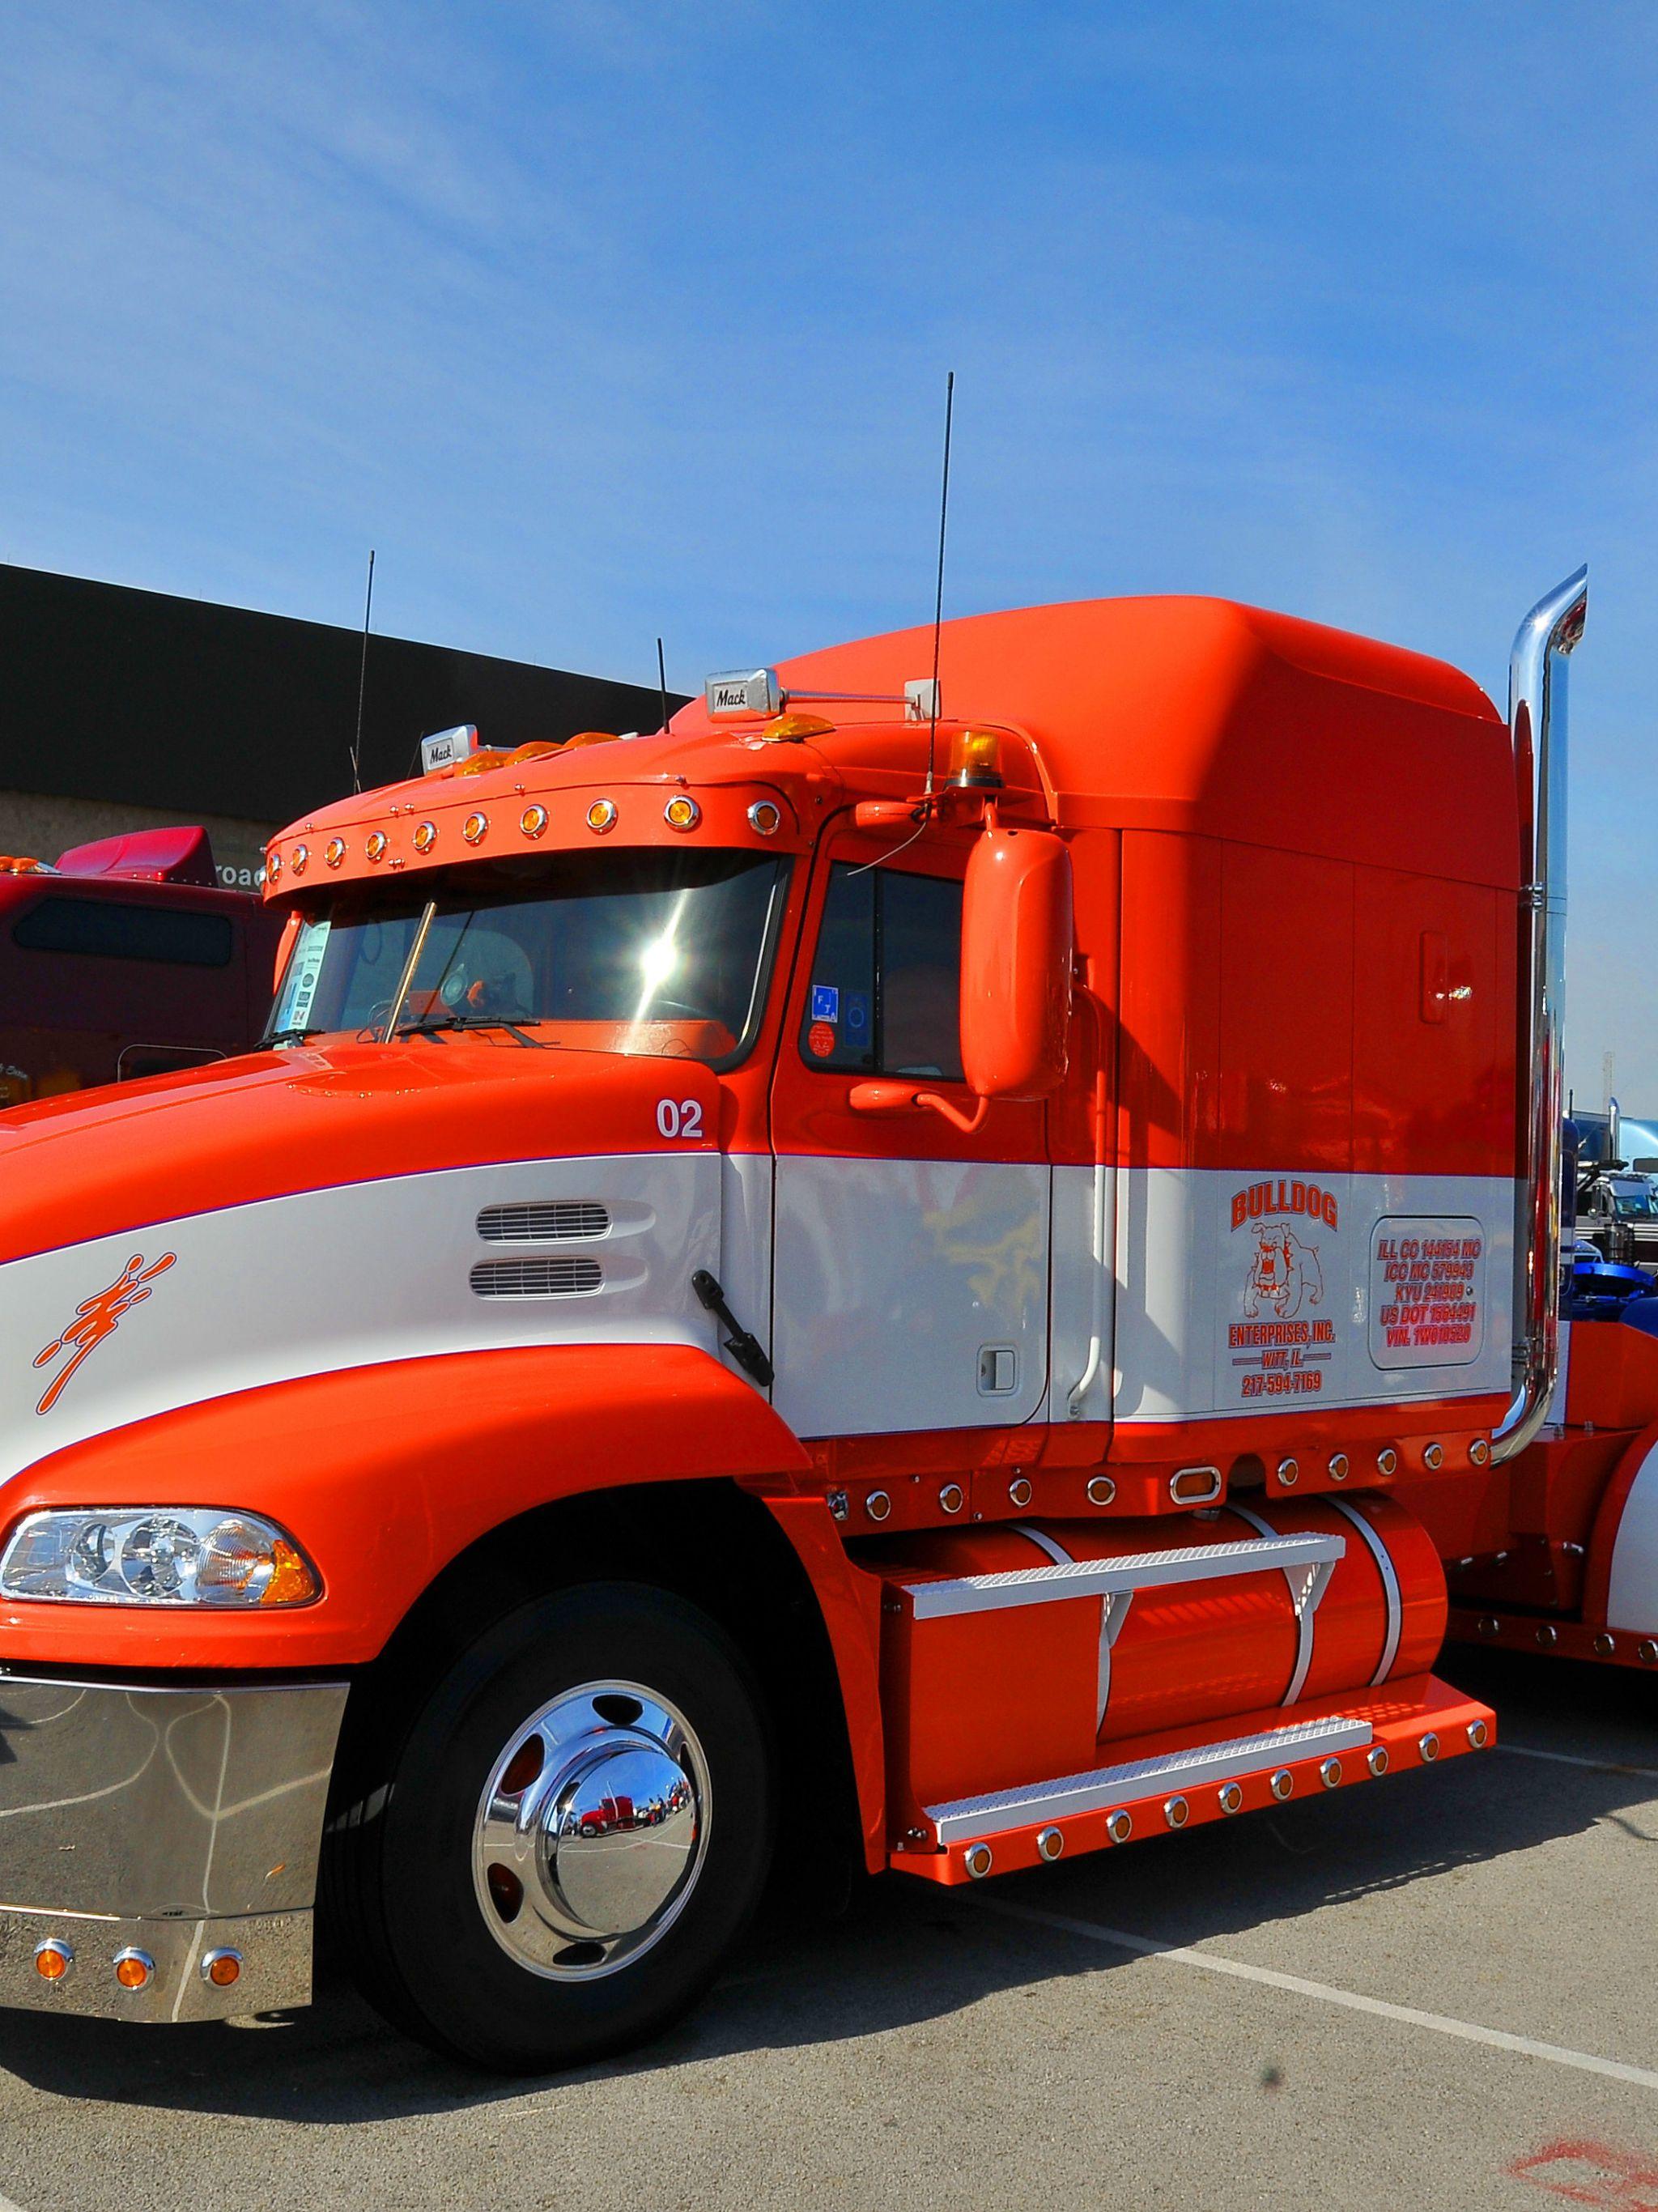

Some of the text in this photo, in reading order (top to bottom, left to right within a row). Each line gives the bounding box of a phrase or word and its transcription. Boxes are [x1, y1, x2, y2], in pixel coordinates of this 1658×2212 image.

[716, 689, 746, 706] Mack
[430, 745, 452, 764] Mack
[657, 1099, 703, 1138] 02
[1231, 1180, 1337, 1232] BULLDOG
[1377, 1240, 1398, 1260] ILL
[1460, 1239, 1482, 1259] MC
[1384, 1261, 1409, 1282] ICC
[1409, 1261, 1430, 1281] MC
[1394, 1283, 1422, 1303] KYU
[1380, 1305, 1399, 1325] US
[1400, 1304, 1429, 1325] DOT
[1228, 1320, 1336, 1349] ENTERPRISES, INC.
[1241, 1370, 1322, 1397] 217-594-7169
